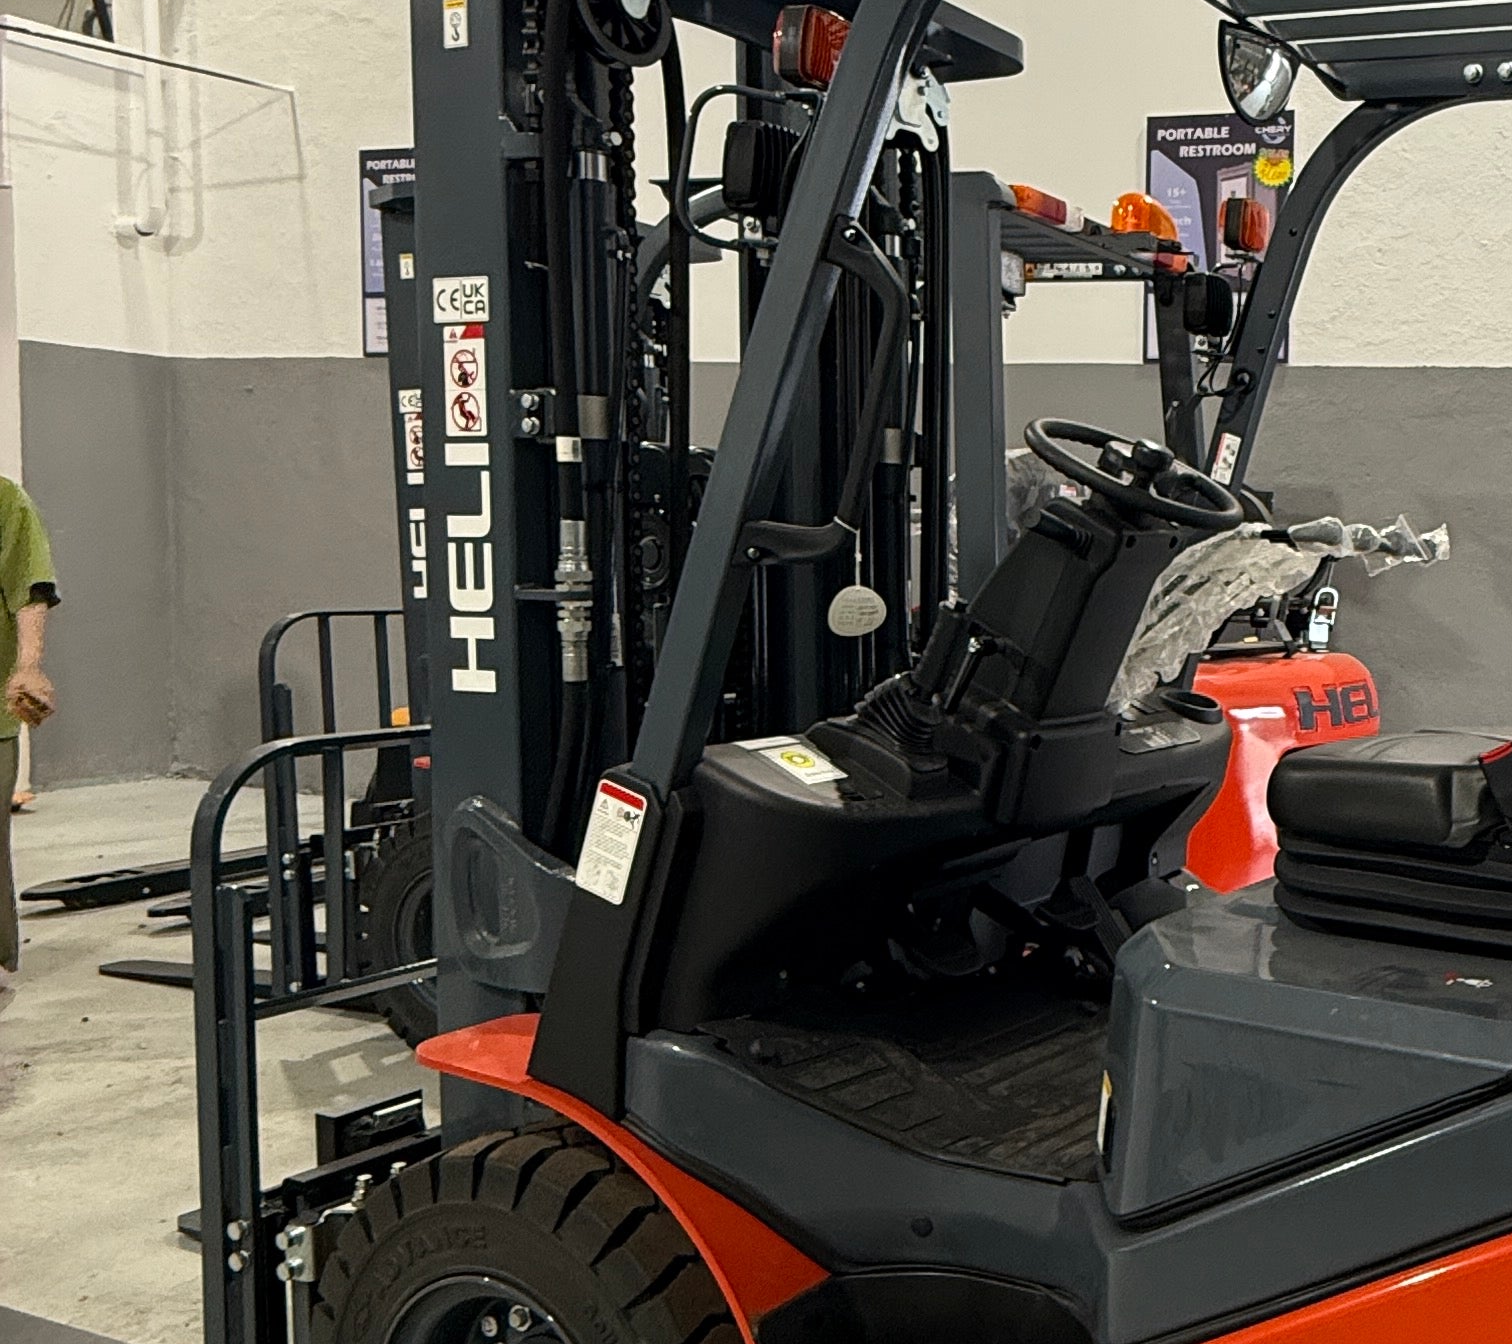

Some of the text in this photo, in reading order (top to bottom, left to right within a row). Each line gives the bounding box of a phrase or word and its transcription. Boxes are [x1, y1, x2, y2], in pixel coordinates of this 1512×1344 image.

[1157, 126, 1230, 141] PORTABLE
[1179, 143, 1256, 158] RESTROOM
[462, 283, 485, 298] UK
[436, 288, 460, 312] CE
[463, 299, 486, 314] CA
[445, 442, 497, 693] HELI
[1293, 682, 1379, 732] HEL
